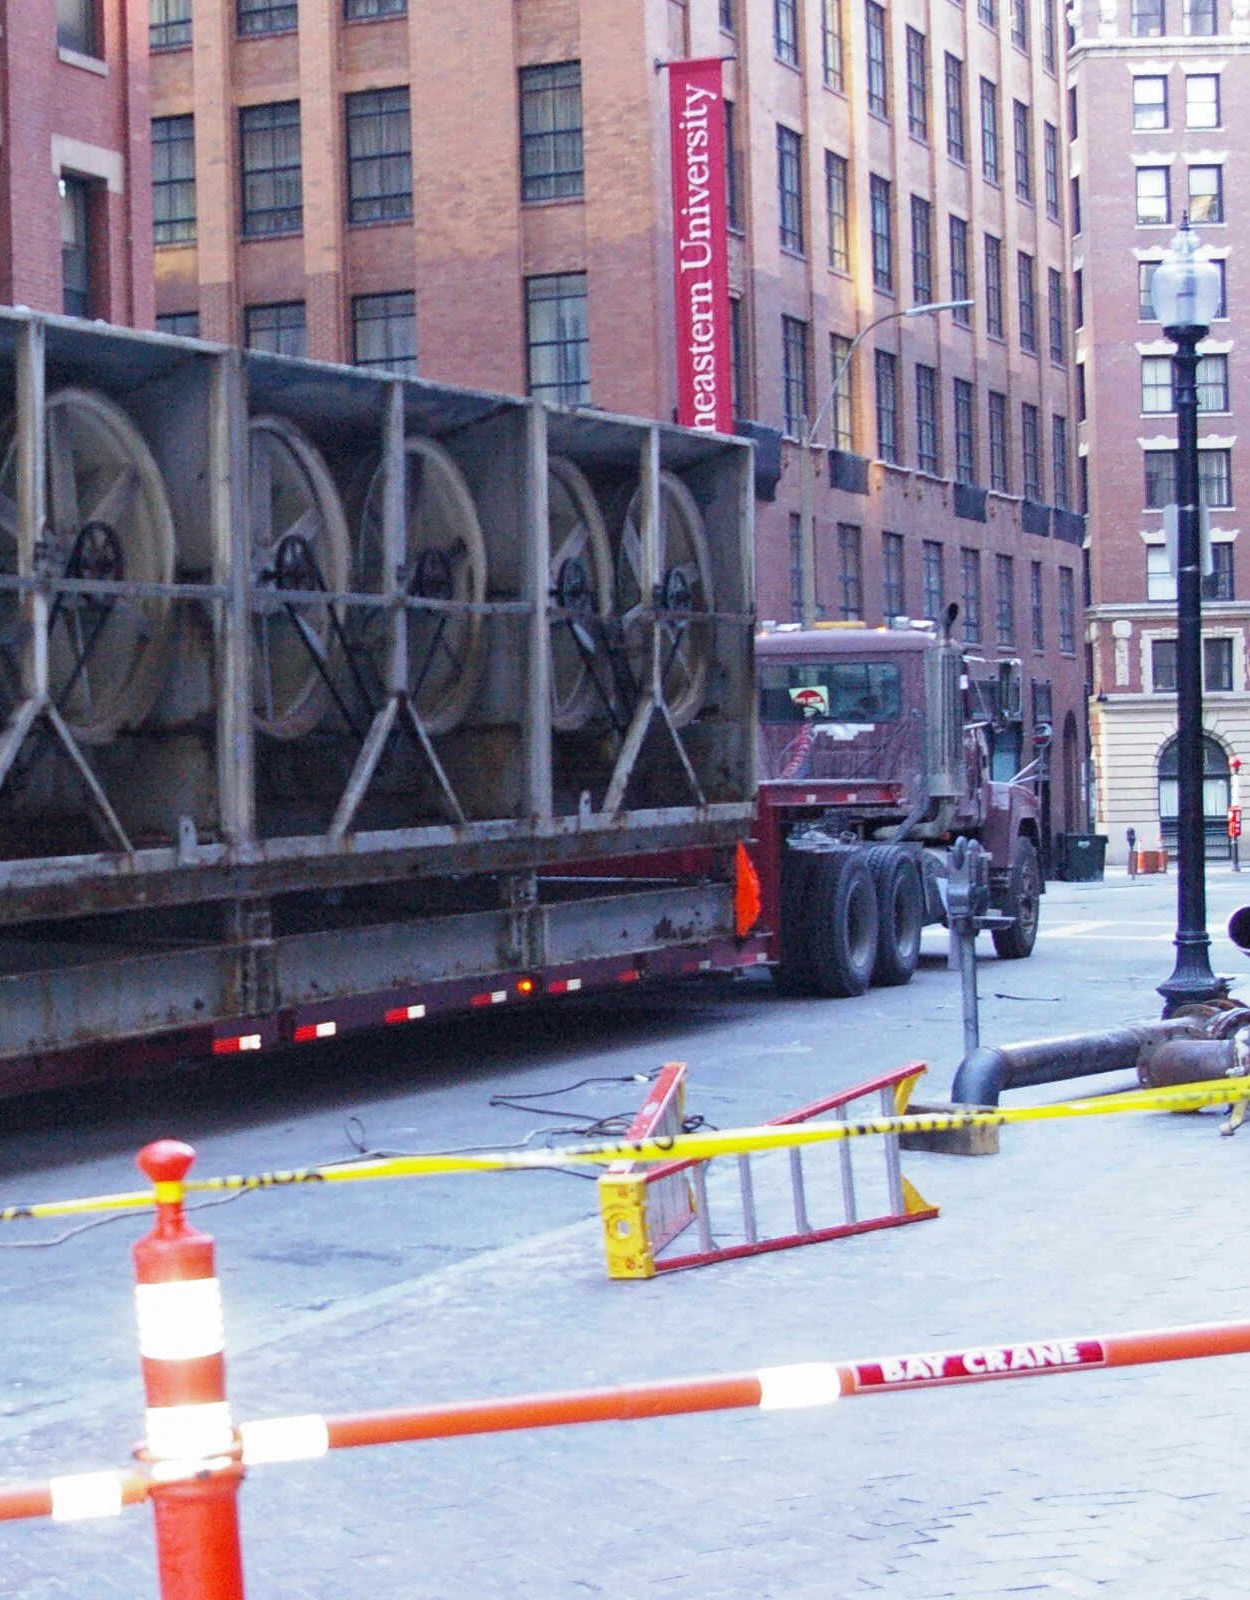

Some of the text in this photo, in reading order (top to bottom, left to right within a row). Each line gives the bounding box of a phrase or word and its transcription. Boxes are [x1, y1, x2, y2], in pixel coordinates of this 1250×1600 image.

[679, 83, 717, 273] University
[881, 1342, 1081, 1383] BAY CRANE
